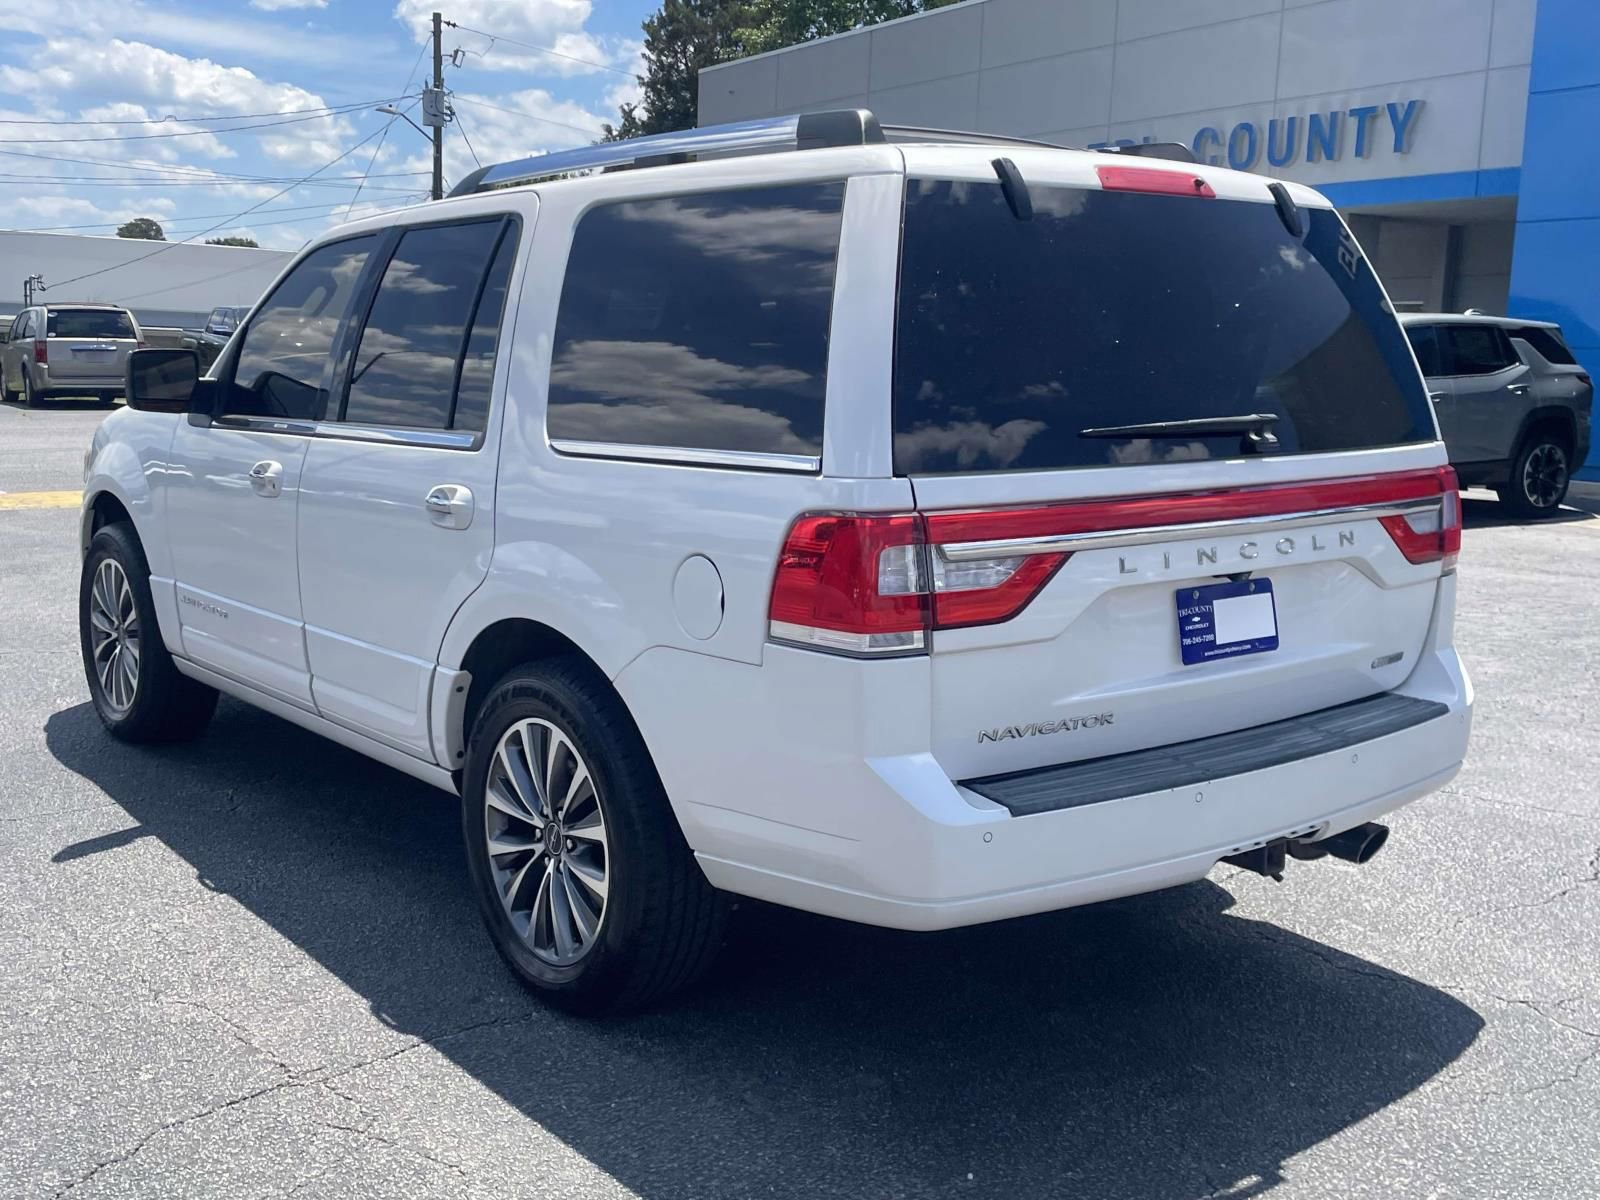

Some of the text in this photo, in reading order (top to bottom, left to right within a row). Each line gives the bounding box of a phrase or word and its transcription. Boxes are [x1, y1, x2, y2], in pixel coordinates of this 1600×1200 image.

[1192, 100, 1422, 171] COUNTY
[1119, 530, 1355, 574] LINCOLN
[978, 712, 1114, 744] NAVIGATOR
